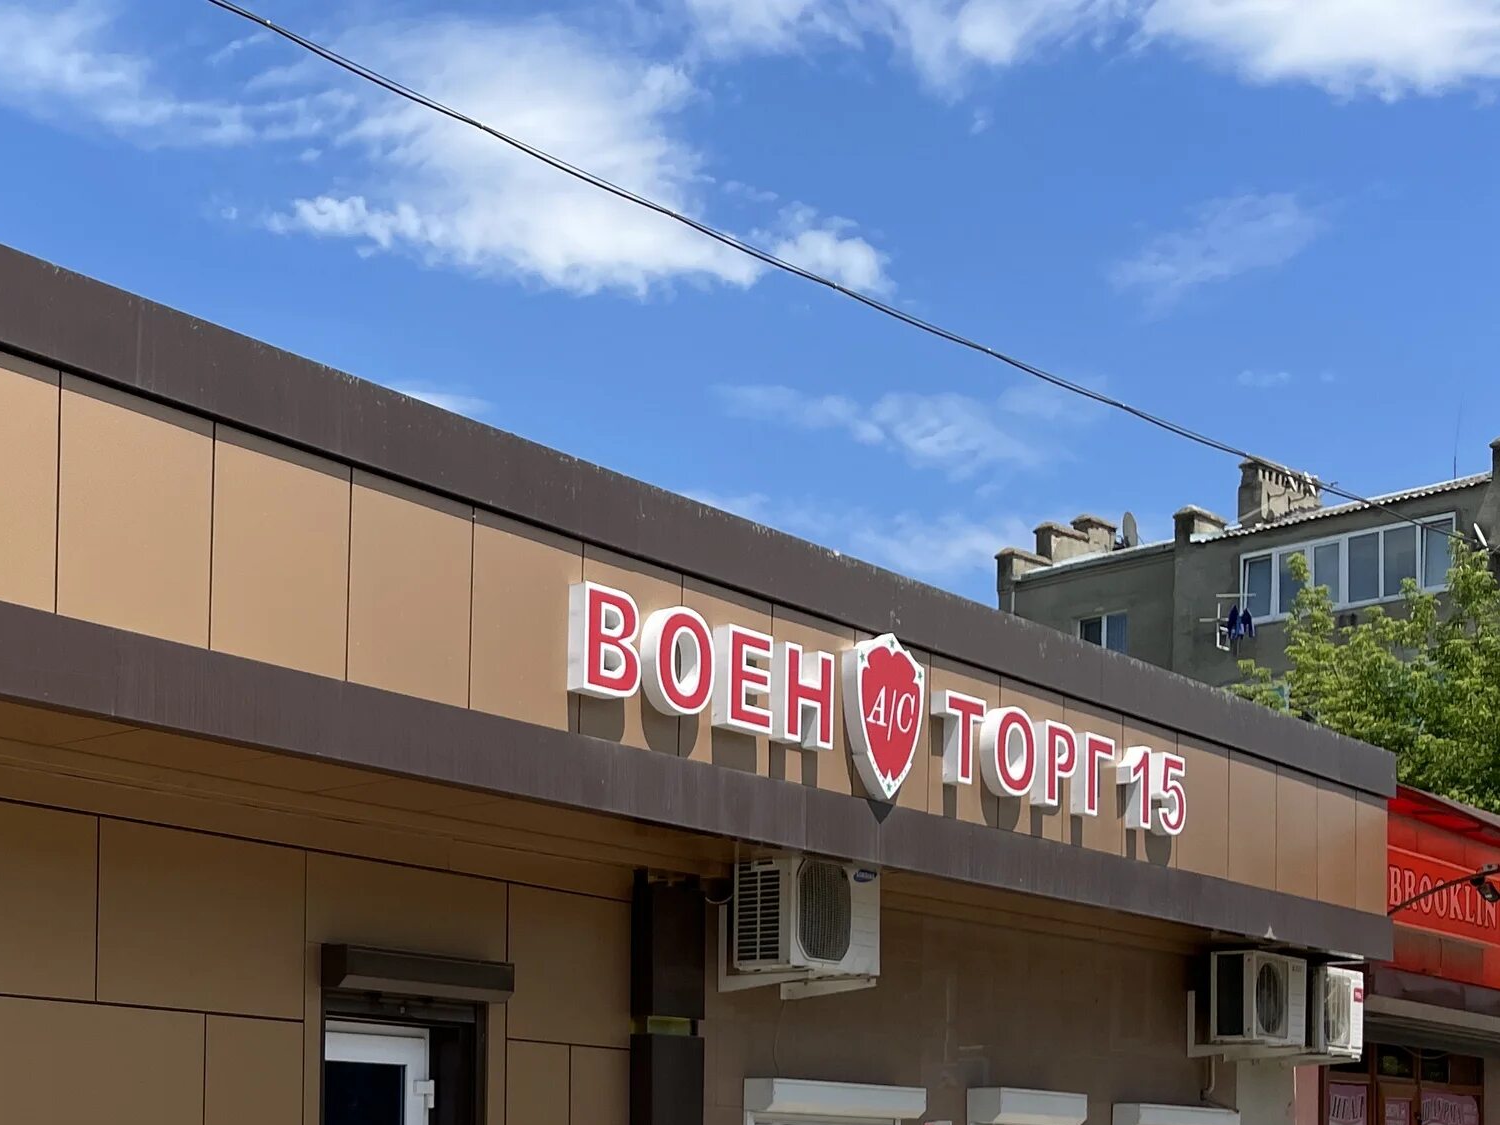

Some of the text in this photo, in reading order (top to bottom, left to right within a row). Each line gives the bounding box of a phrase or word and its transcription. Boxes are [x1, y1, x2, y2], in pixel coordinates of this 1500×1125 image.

[568, 580, 836, 752] ВОЕН
[930, 689, 1116, 817] ТОРГ
[1116, 745, 1187, 836] 15
[1388, 865, 1497, 930] BROOKLIN
